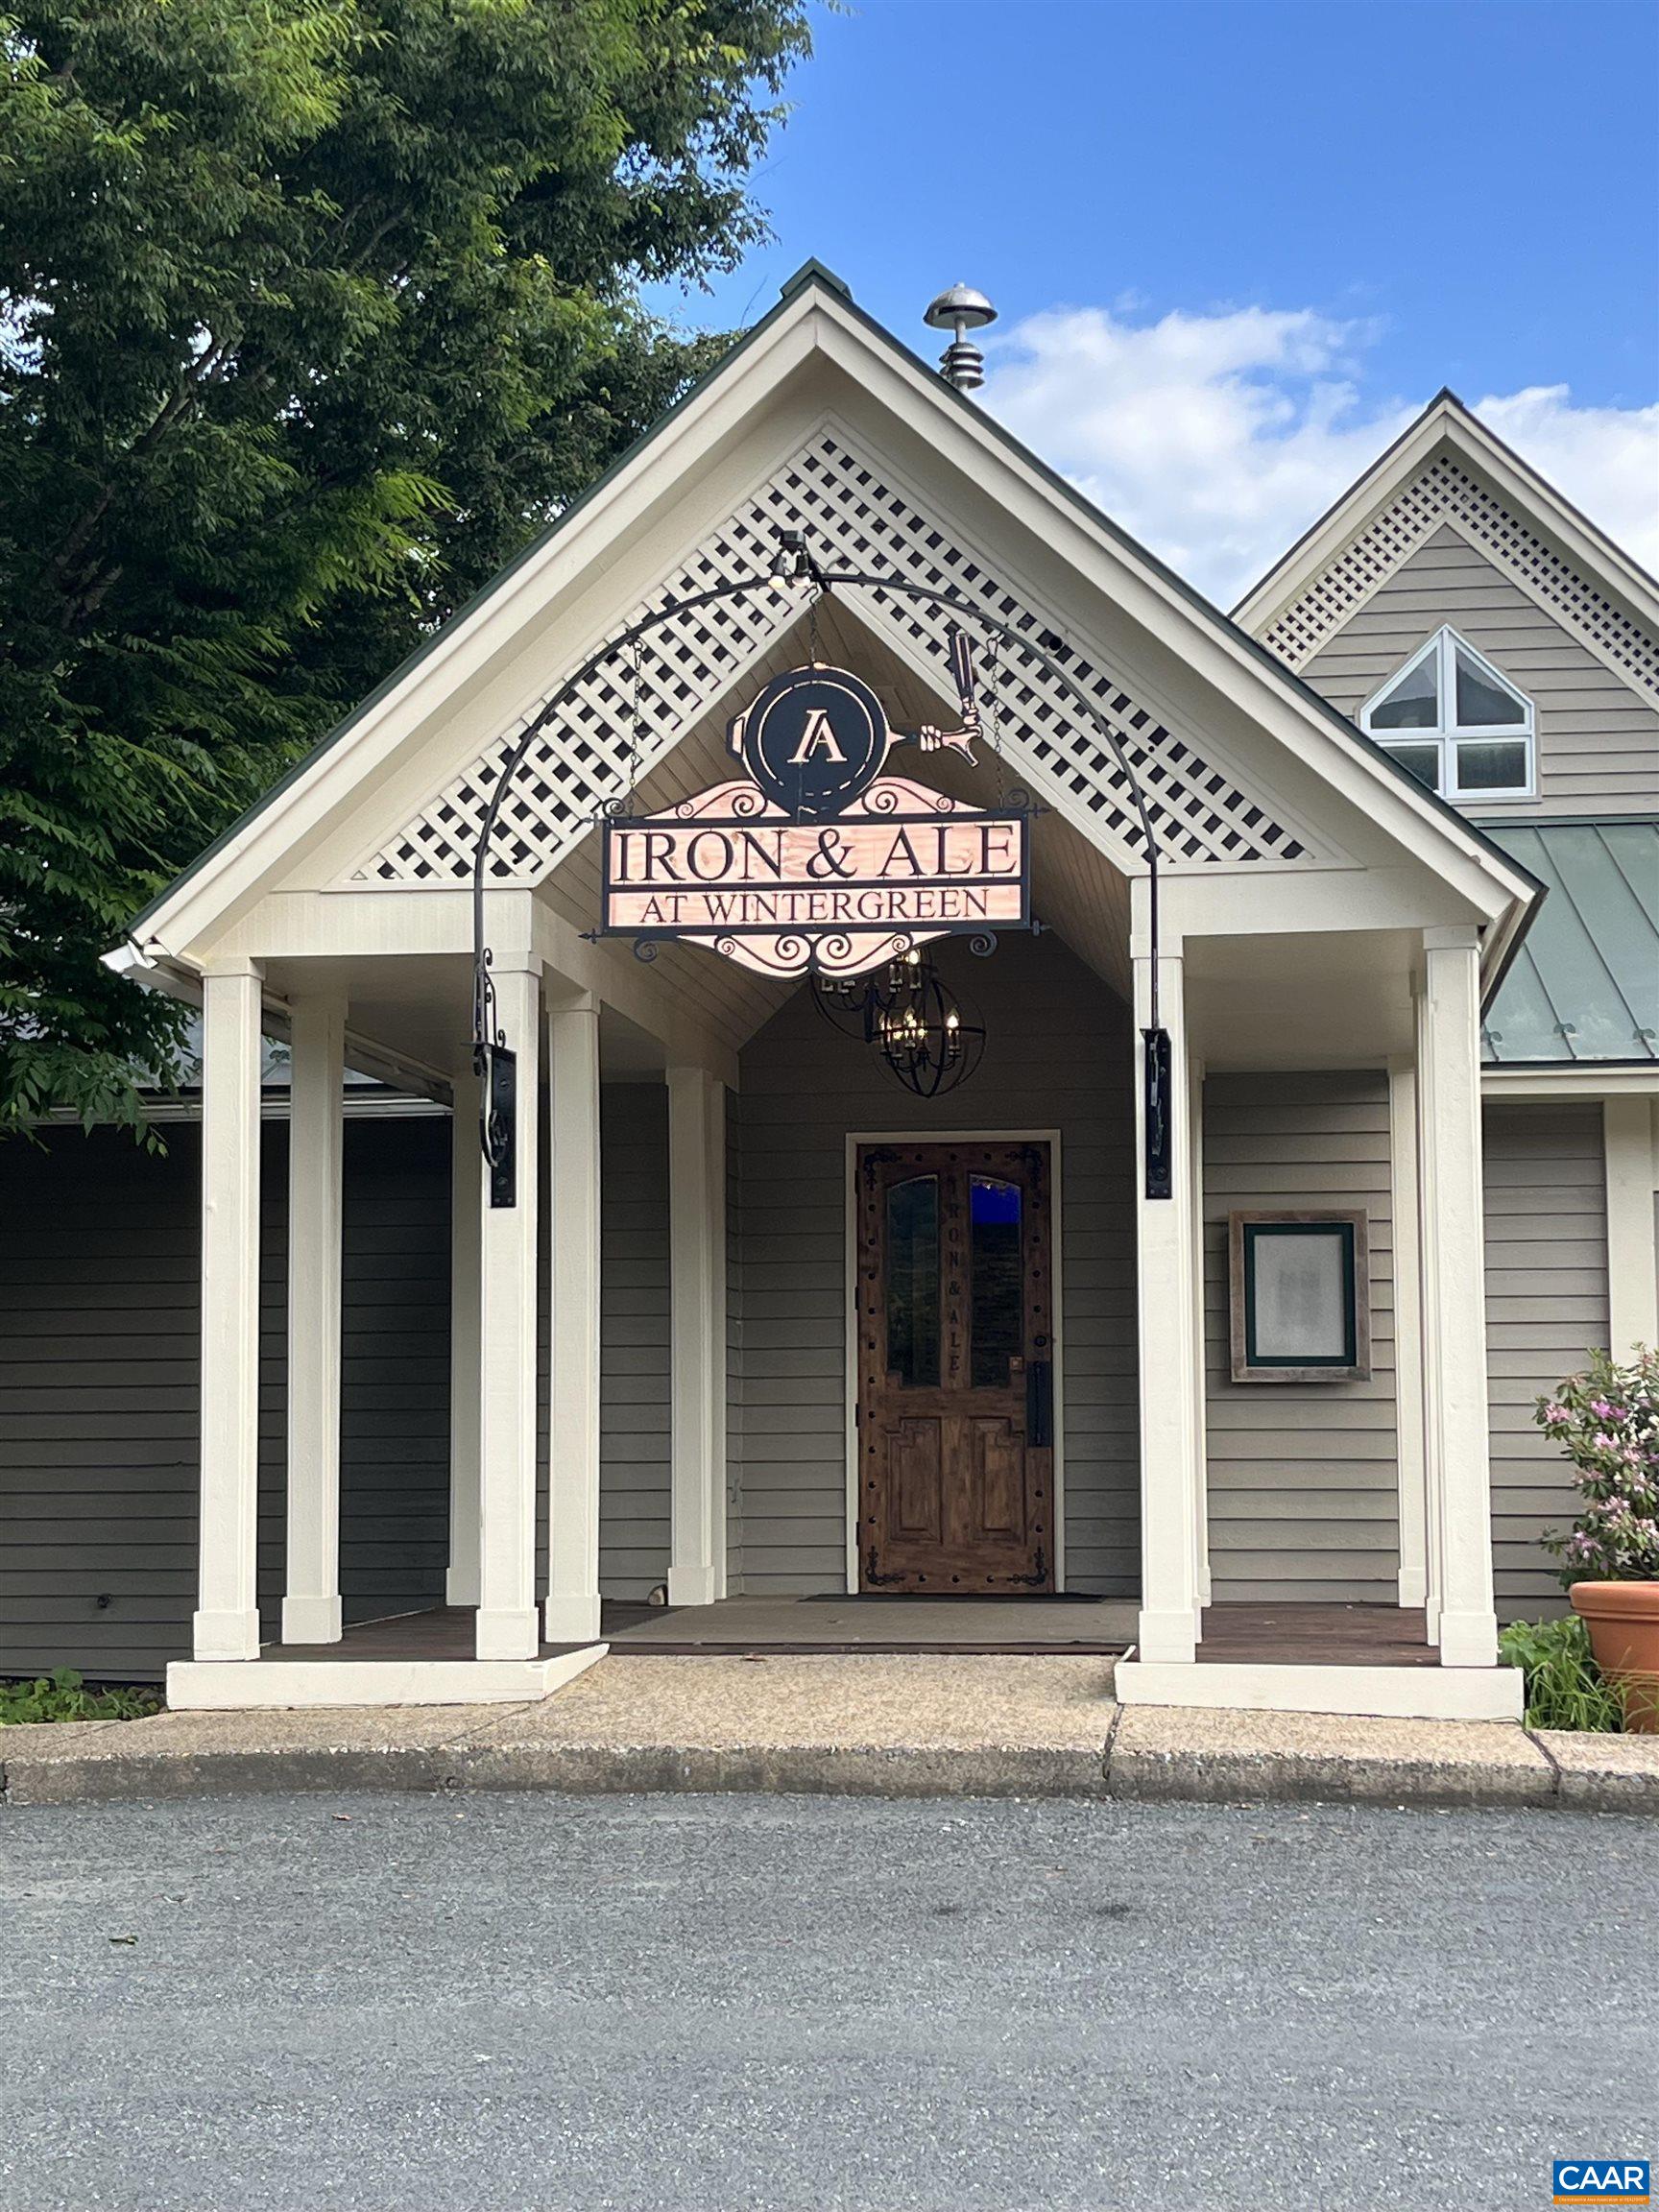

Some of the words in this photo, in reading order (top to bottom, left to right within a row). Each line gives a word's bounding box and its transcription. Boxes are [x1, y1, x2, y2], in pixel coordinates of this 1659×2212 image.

[613, 827, 789, 882] IRON
[805, 827, 858, 880] &
[877, 824, 1018, 878] ALE
[638, 895, 688, 924] AT
[703, 887, 990, 923] WINTERGREEN
